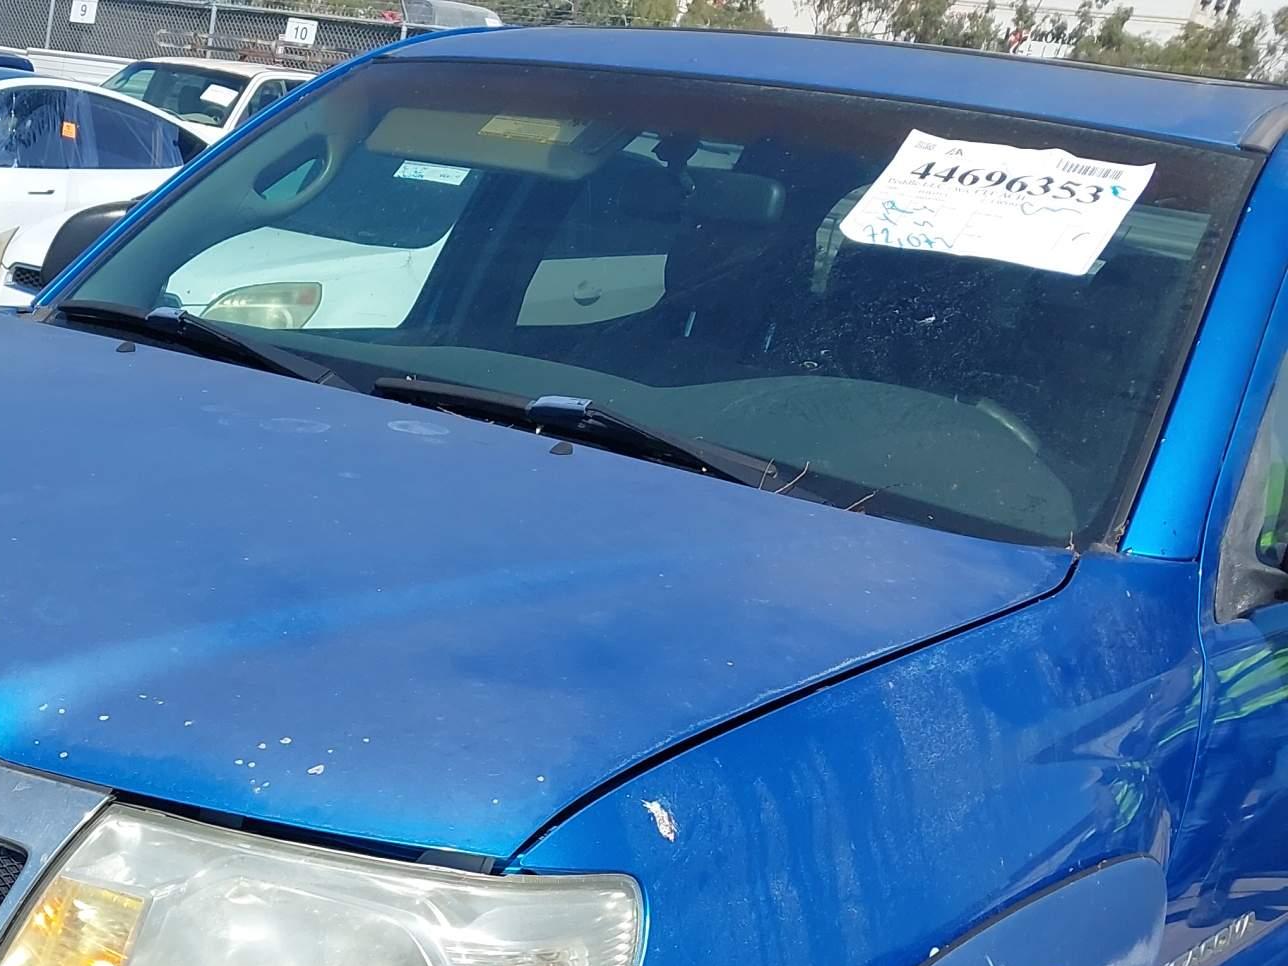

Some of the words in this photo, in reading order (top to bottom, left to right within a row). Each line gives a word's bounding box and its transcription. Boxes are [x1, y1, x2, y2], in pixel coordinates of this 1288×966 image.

[79, 5, 87, 17] 9
[293, 26, 308, 41] 10
[910, 161, 1105, 204] 44696353
